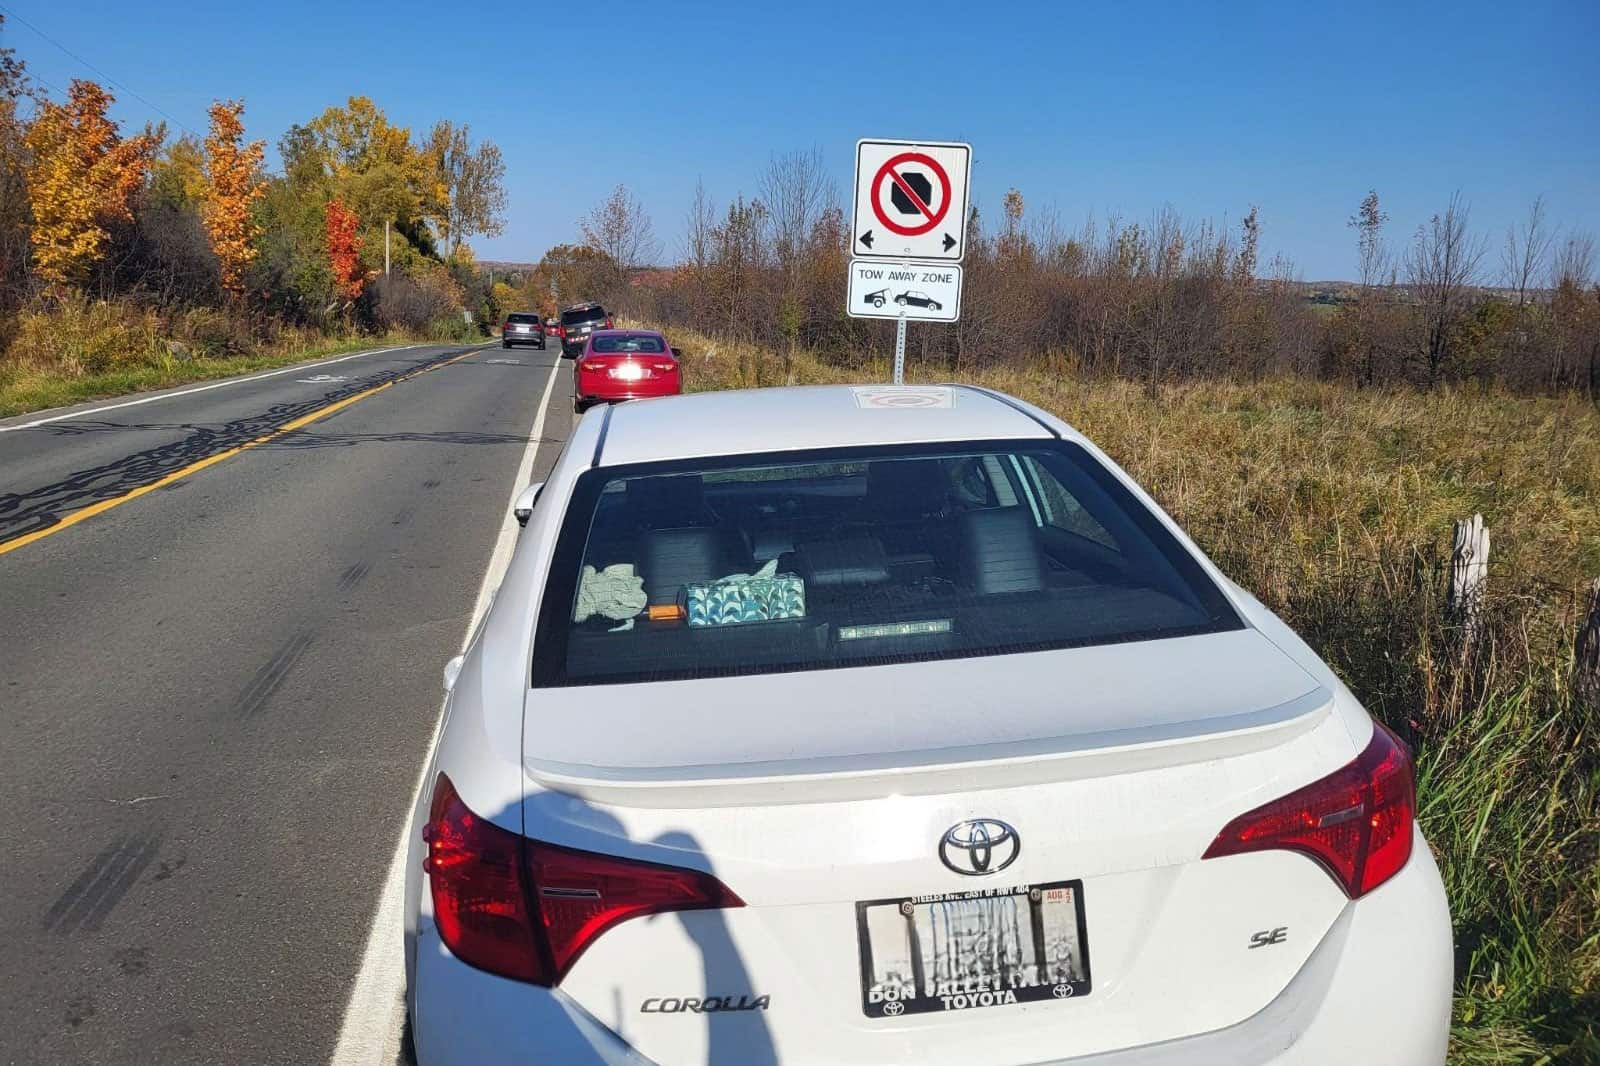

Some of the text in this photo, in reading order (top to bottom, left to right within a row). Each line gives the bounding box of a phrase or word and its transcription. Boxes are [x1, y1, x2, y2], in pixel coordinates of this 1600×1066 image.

[859, 269, 953, 284] TOW AWAY ZONE
[1047, 890, 1063, 899] AUG
[1248, 927, 1288, 949] SE
[869, 986, 916, 1003] DON
[941, 989, 1017, 1010] TOYOTA
[640, 995, 770, 1013] COROLLA
